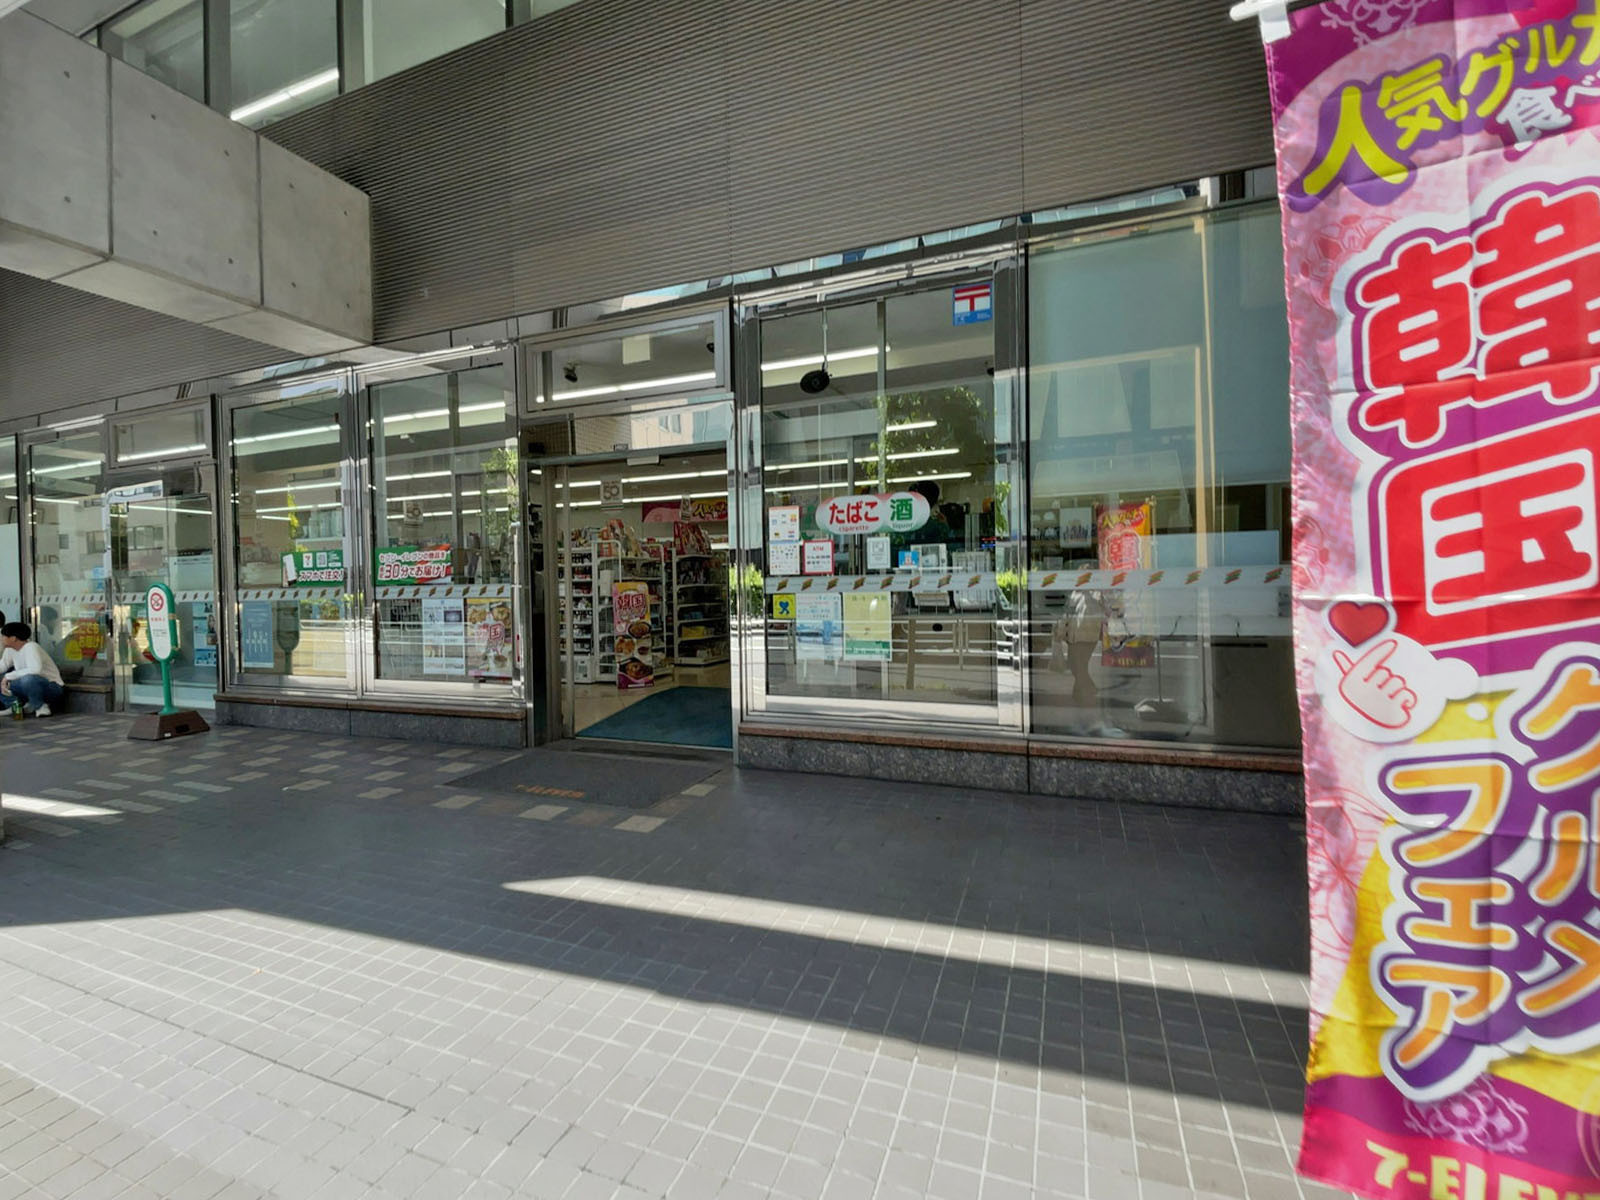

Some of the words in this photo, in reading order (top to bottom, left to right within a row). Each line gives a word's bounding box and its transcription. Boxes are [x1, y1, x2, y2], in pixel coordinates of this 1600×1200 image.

[829, 501, 879, 525] たばこ
[890, 498, 913, 521] 酒
[1389, 760, 1512, 1066] フェア
